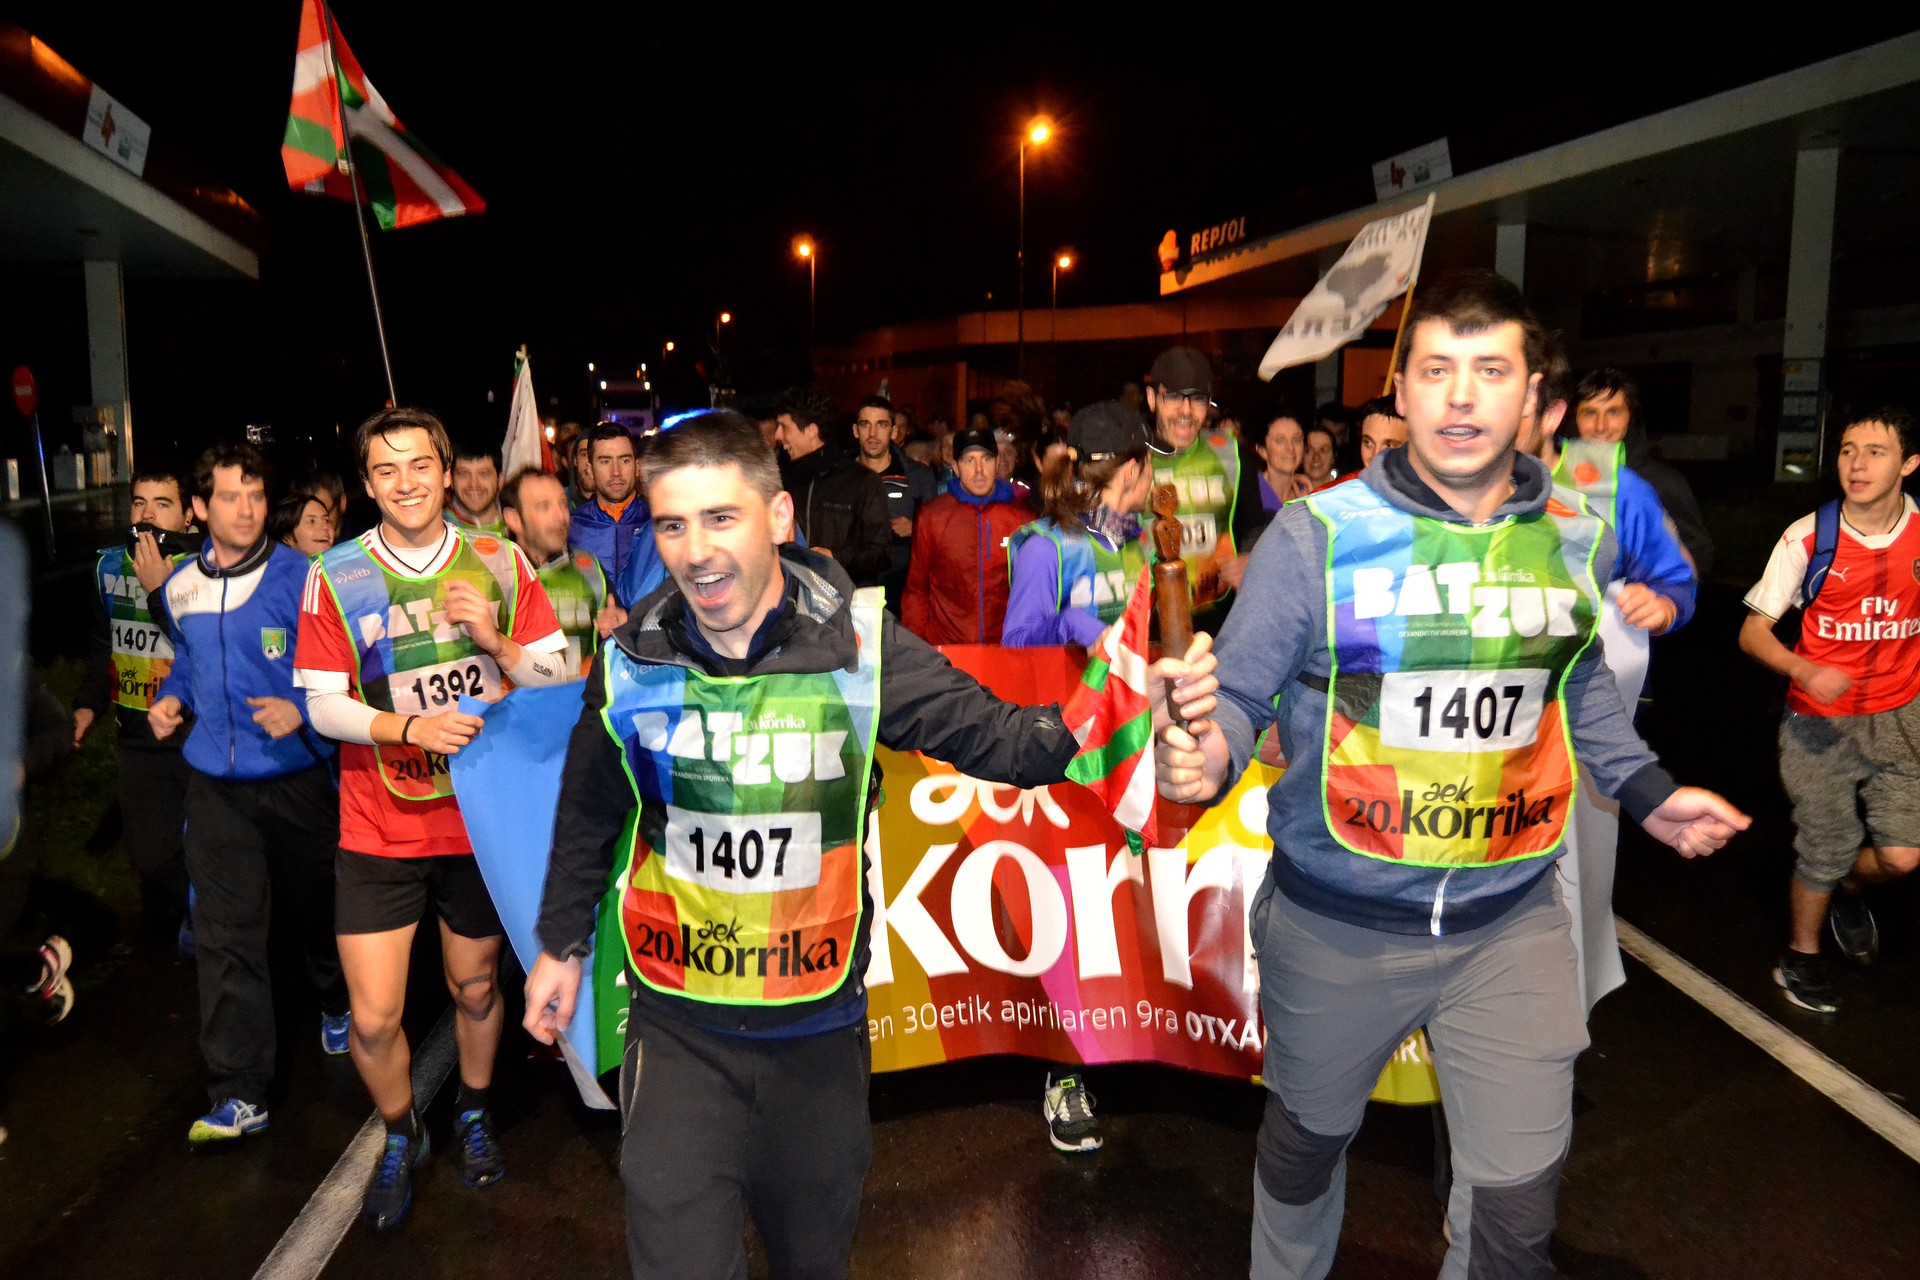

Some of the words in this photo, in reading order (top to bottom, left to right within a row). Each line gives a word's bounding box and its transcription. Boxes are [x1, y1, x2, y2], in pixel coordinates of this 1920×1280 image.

[1191, 216, 1246, 256] REPSOL
[348, 567, 371, 582] eitb
[1352, 562, 1481, 620] BAT
[1470, 586, 1578, 638] ZUK
[1861, 596, 1898, 617] Fly
[116, 625, 160, 653] 1407
[121, 666, 138, 680] aek
[412, 664, 483, 710] 1392
[1413, 685, 1525, 740] 1407
[632, 710, 743, 762] BAT
[732, 731, 849, 786] ZUK
[1422, 776, 1475, 804] aek
[689, 827, 792, 879] 1407
[697, 916, 743, 944] aek
[901, 994, 993, 1035] 30etik
[1000, 998, 1128, 1033] apirilaren
[1136, 999, 1180, 1033] 9ra
[1184, 1010, 1264, 1052] OTXA
